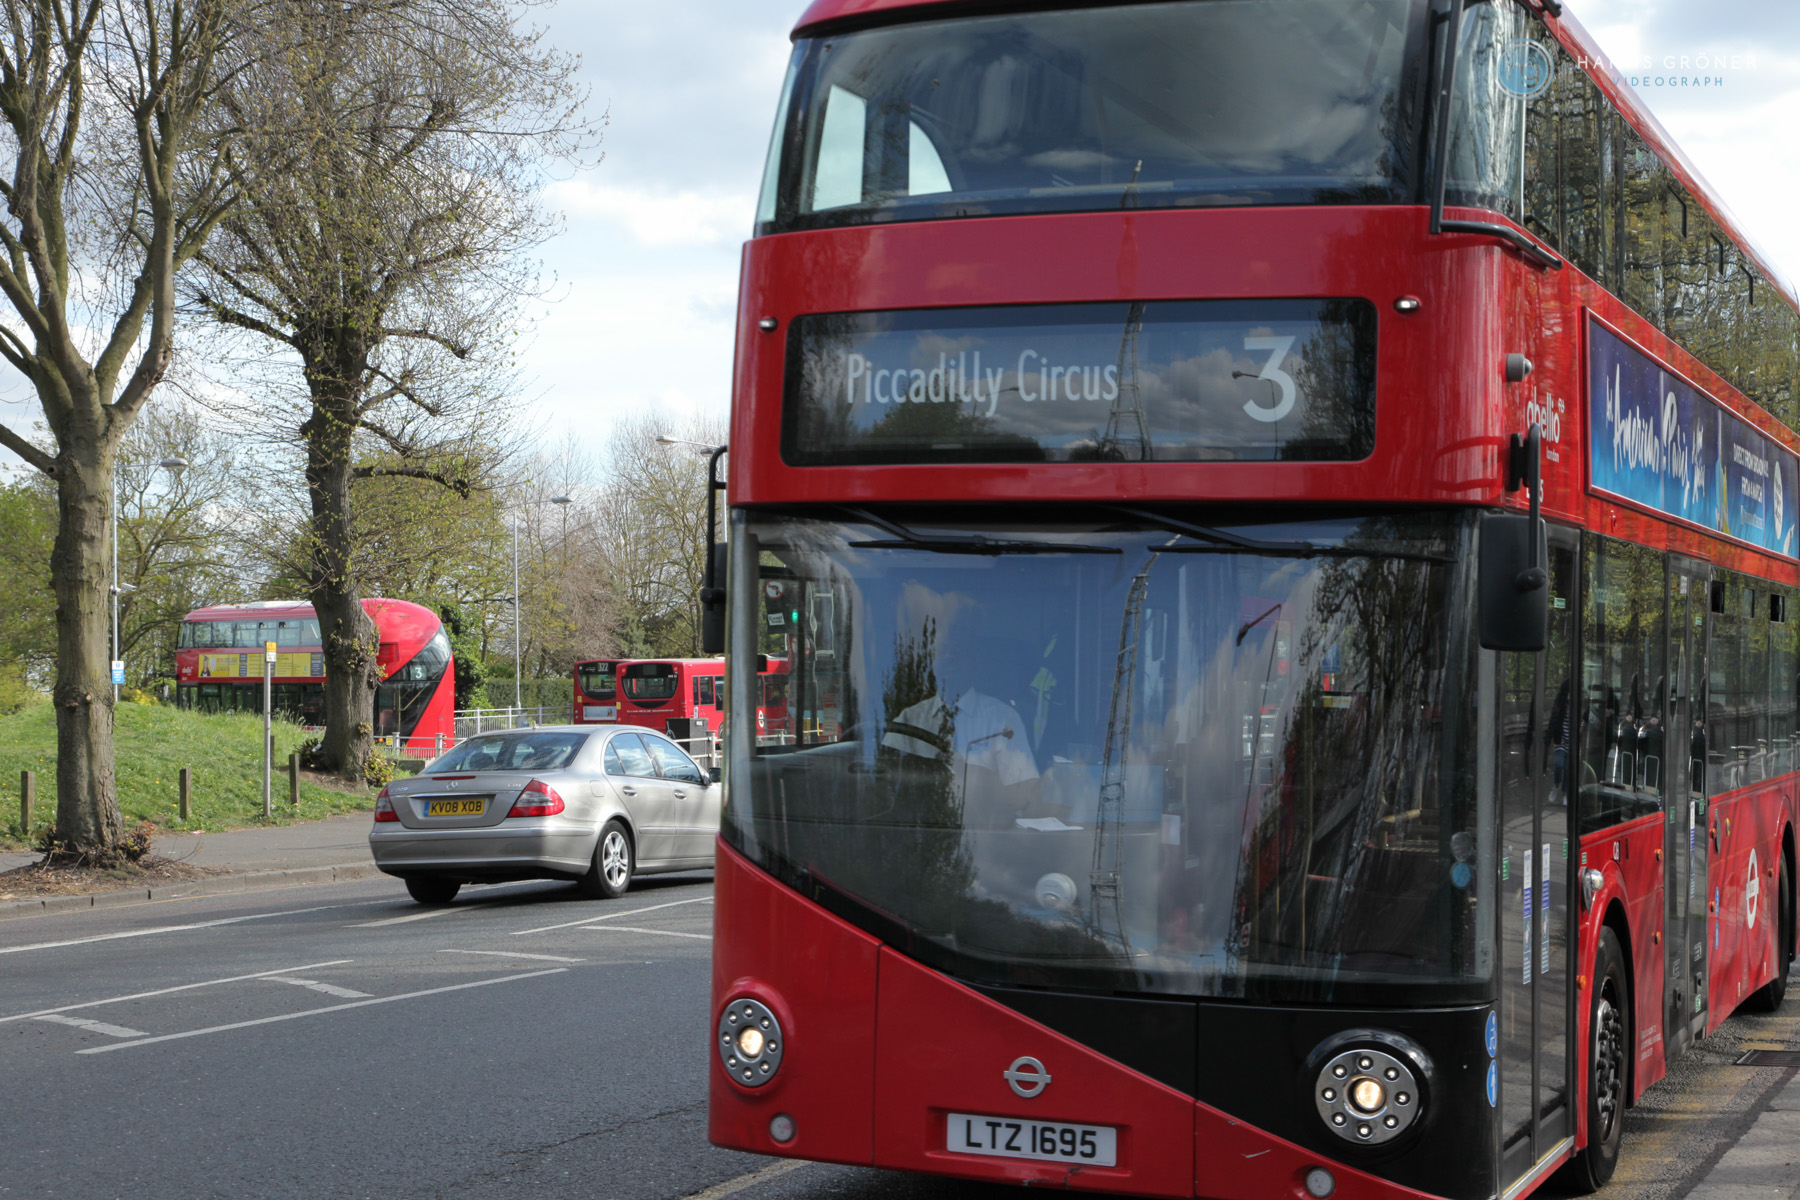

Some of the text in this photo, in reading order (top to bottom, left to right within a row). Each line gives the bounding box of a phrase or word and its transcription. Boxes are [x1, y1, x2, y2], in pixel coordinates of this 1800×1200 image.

[846, 349, 1118, 418] Piccadilly Circus
[1242, 335, 1296, 423] 3
[414, 667, 423, 679] 3
[430, 801, 482, 814] KV08 XOB
[966, 1119, 1097, 1159] LTZ 1695
